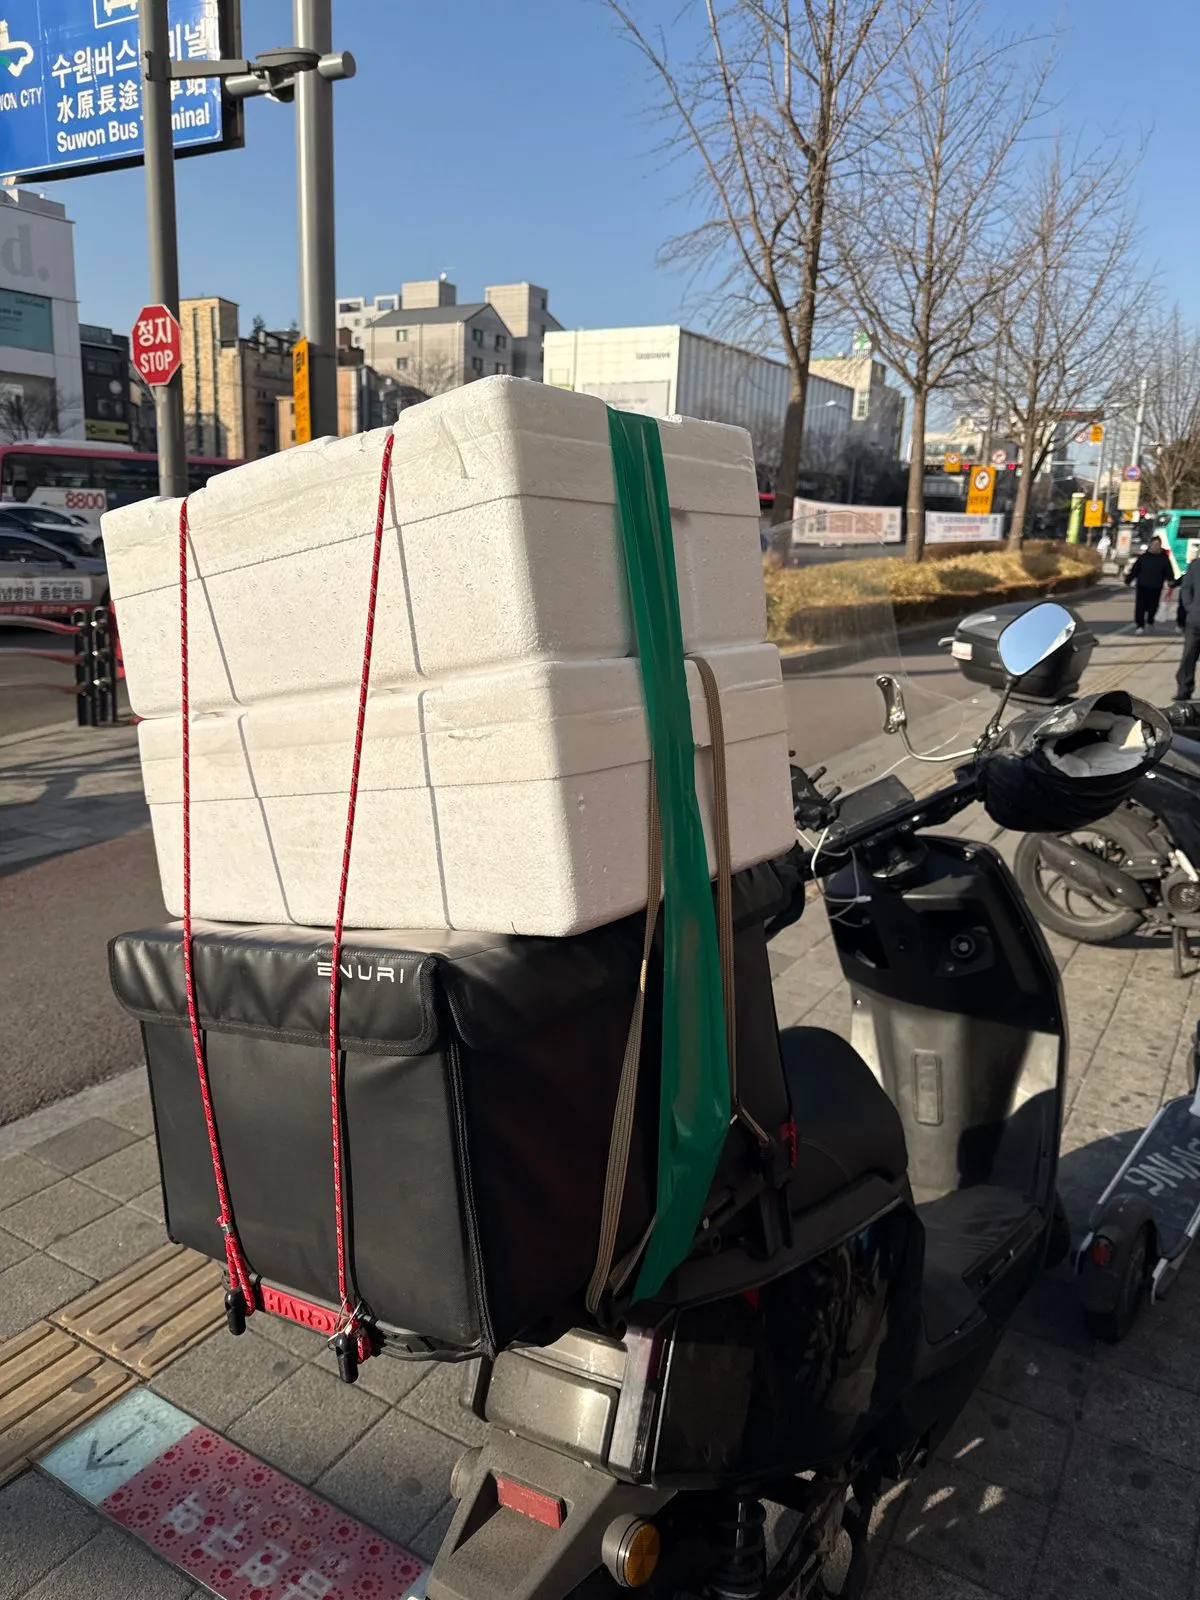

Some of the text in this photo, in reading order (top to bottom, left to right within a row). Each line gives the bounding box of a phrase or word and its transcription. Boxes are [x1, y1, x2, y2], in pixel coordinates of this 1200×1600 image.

[20, 86, 42, 108] CITY
[56, 129, 106, 153] Suwon
[108, 120, 139, 143] Bus
[137, 316, 172, 347] 정지
[140, 349, 173, 374] STOP
[65, 492, 106, 509] 8800
[316, 960, 405, 984] ENURI
